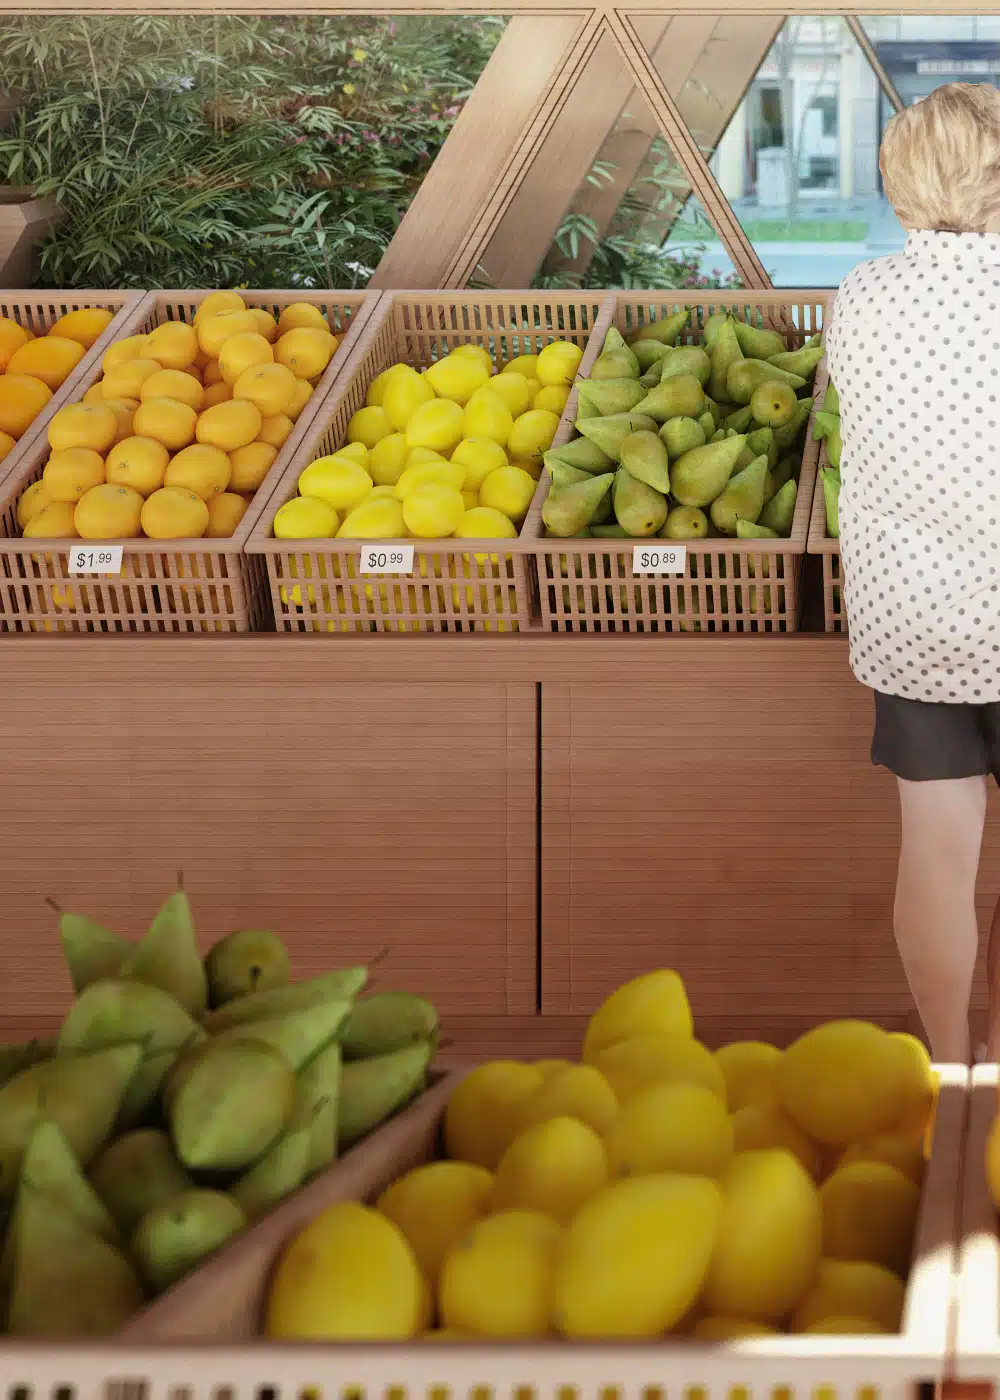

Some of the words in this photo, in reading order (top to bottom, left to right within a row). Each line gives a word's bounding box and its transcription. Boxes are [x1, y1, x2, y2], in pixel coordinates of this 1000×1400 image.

[76, 552, 112, 569] $1.99
[367, 552, 403, 568] $0.99
[640, 552, 676, 569] $0.89
